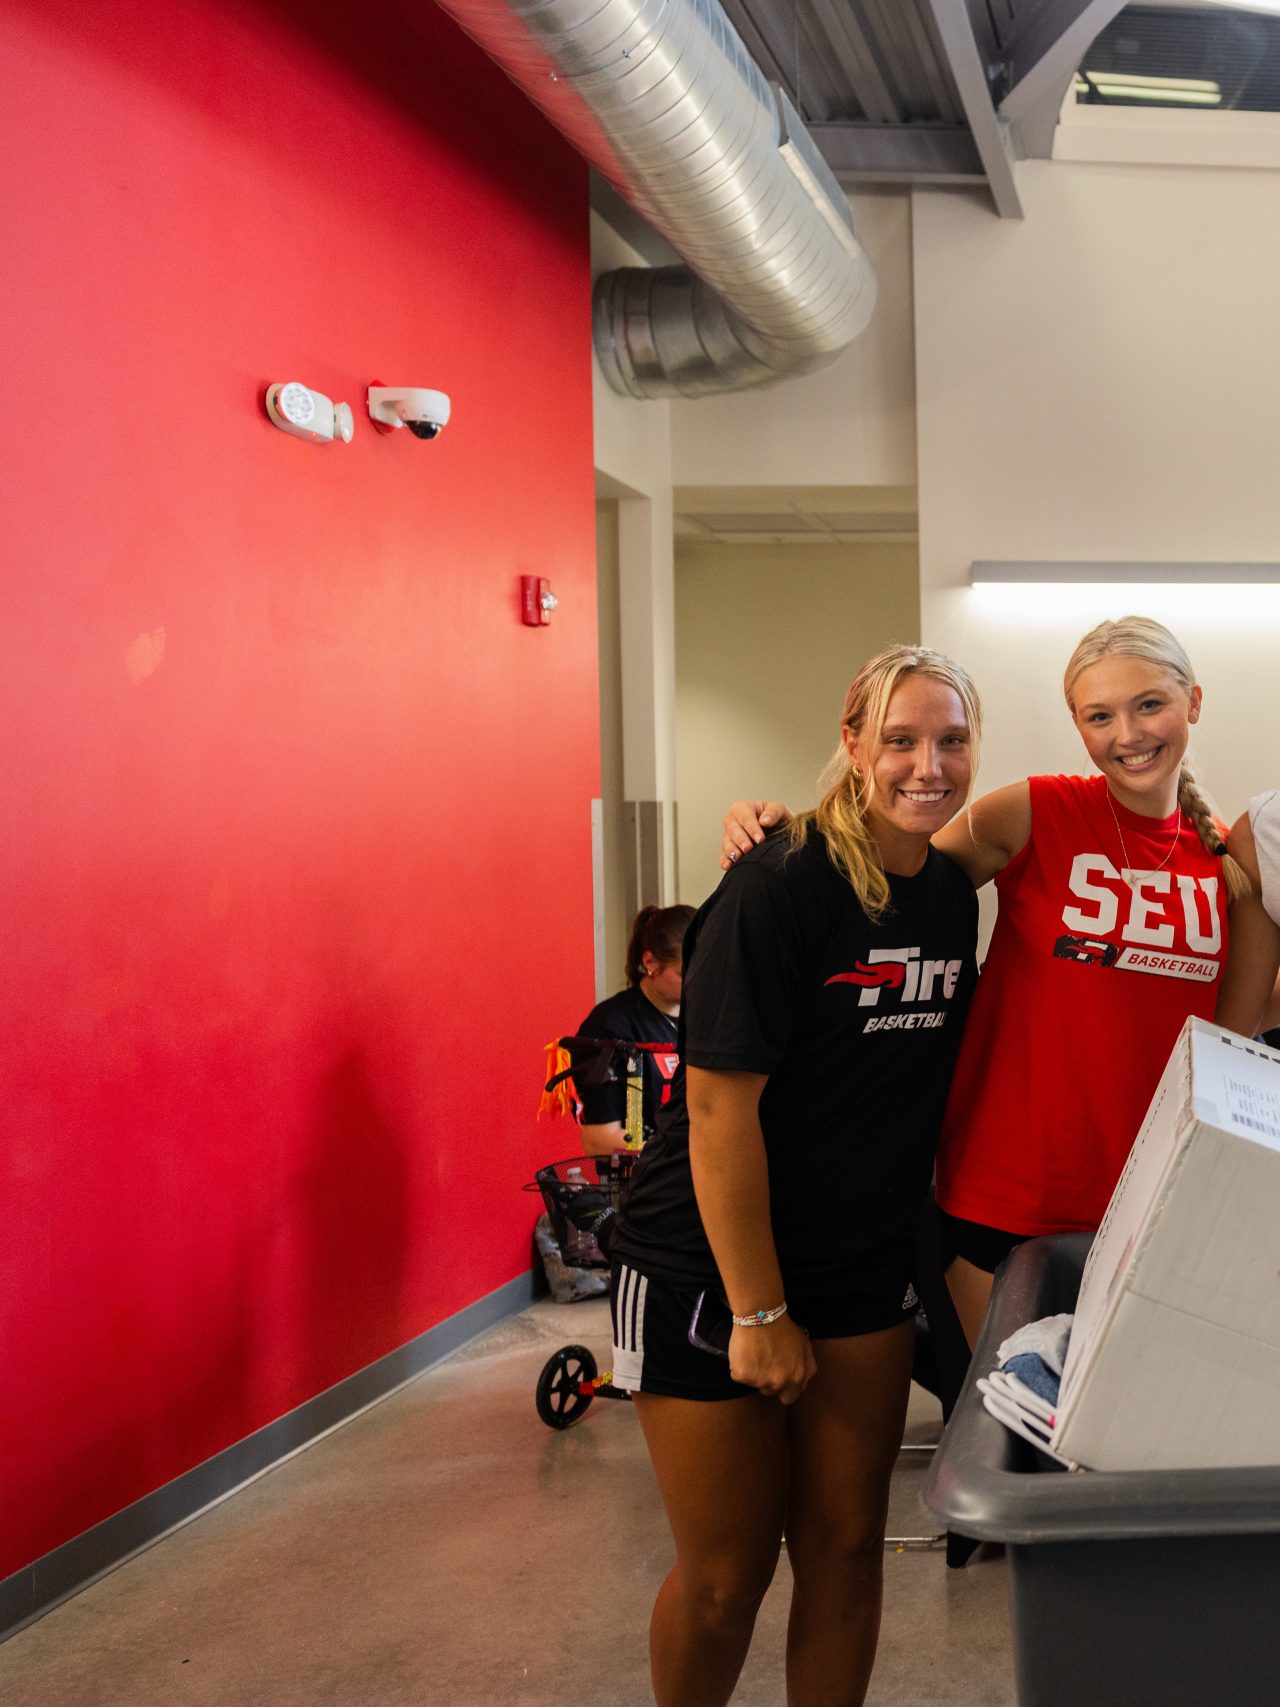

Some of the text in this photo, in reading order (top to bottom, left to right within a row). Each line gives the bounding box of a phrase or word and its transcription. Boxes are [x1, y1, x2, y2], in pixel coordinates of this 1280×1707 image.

[1062, 853, 1221, 955] SEU
[858, 947, 962, 1007] Fire
[1127, 953, 1214, 977] BASKETBALL
